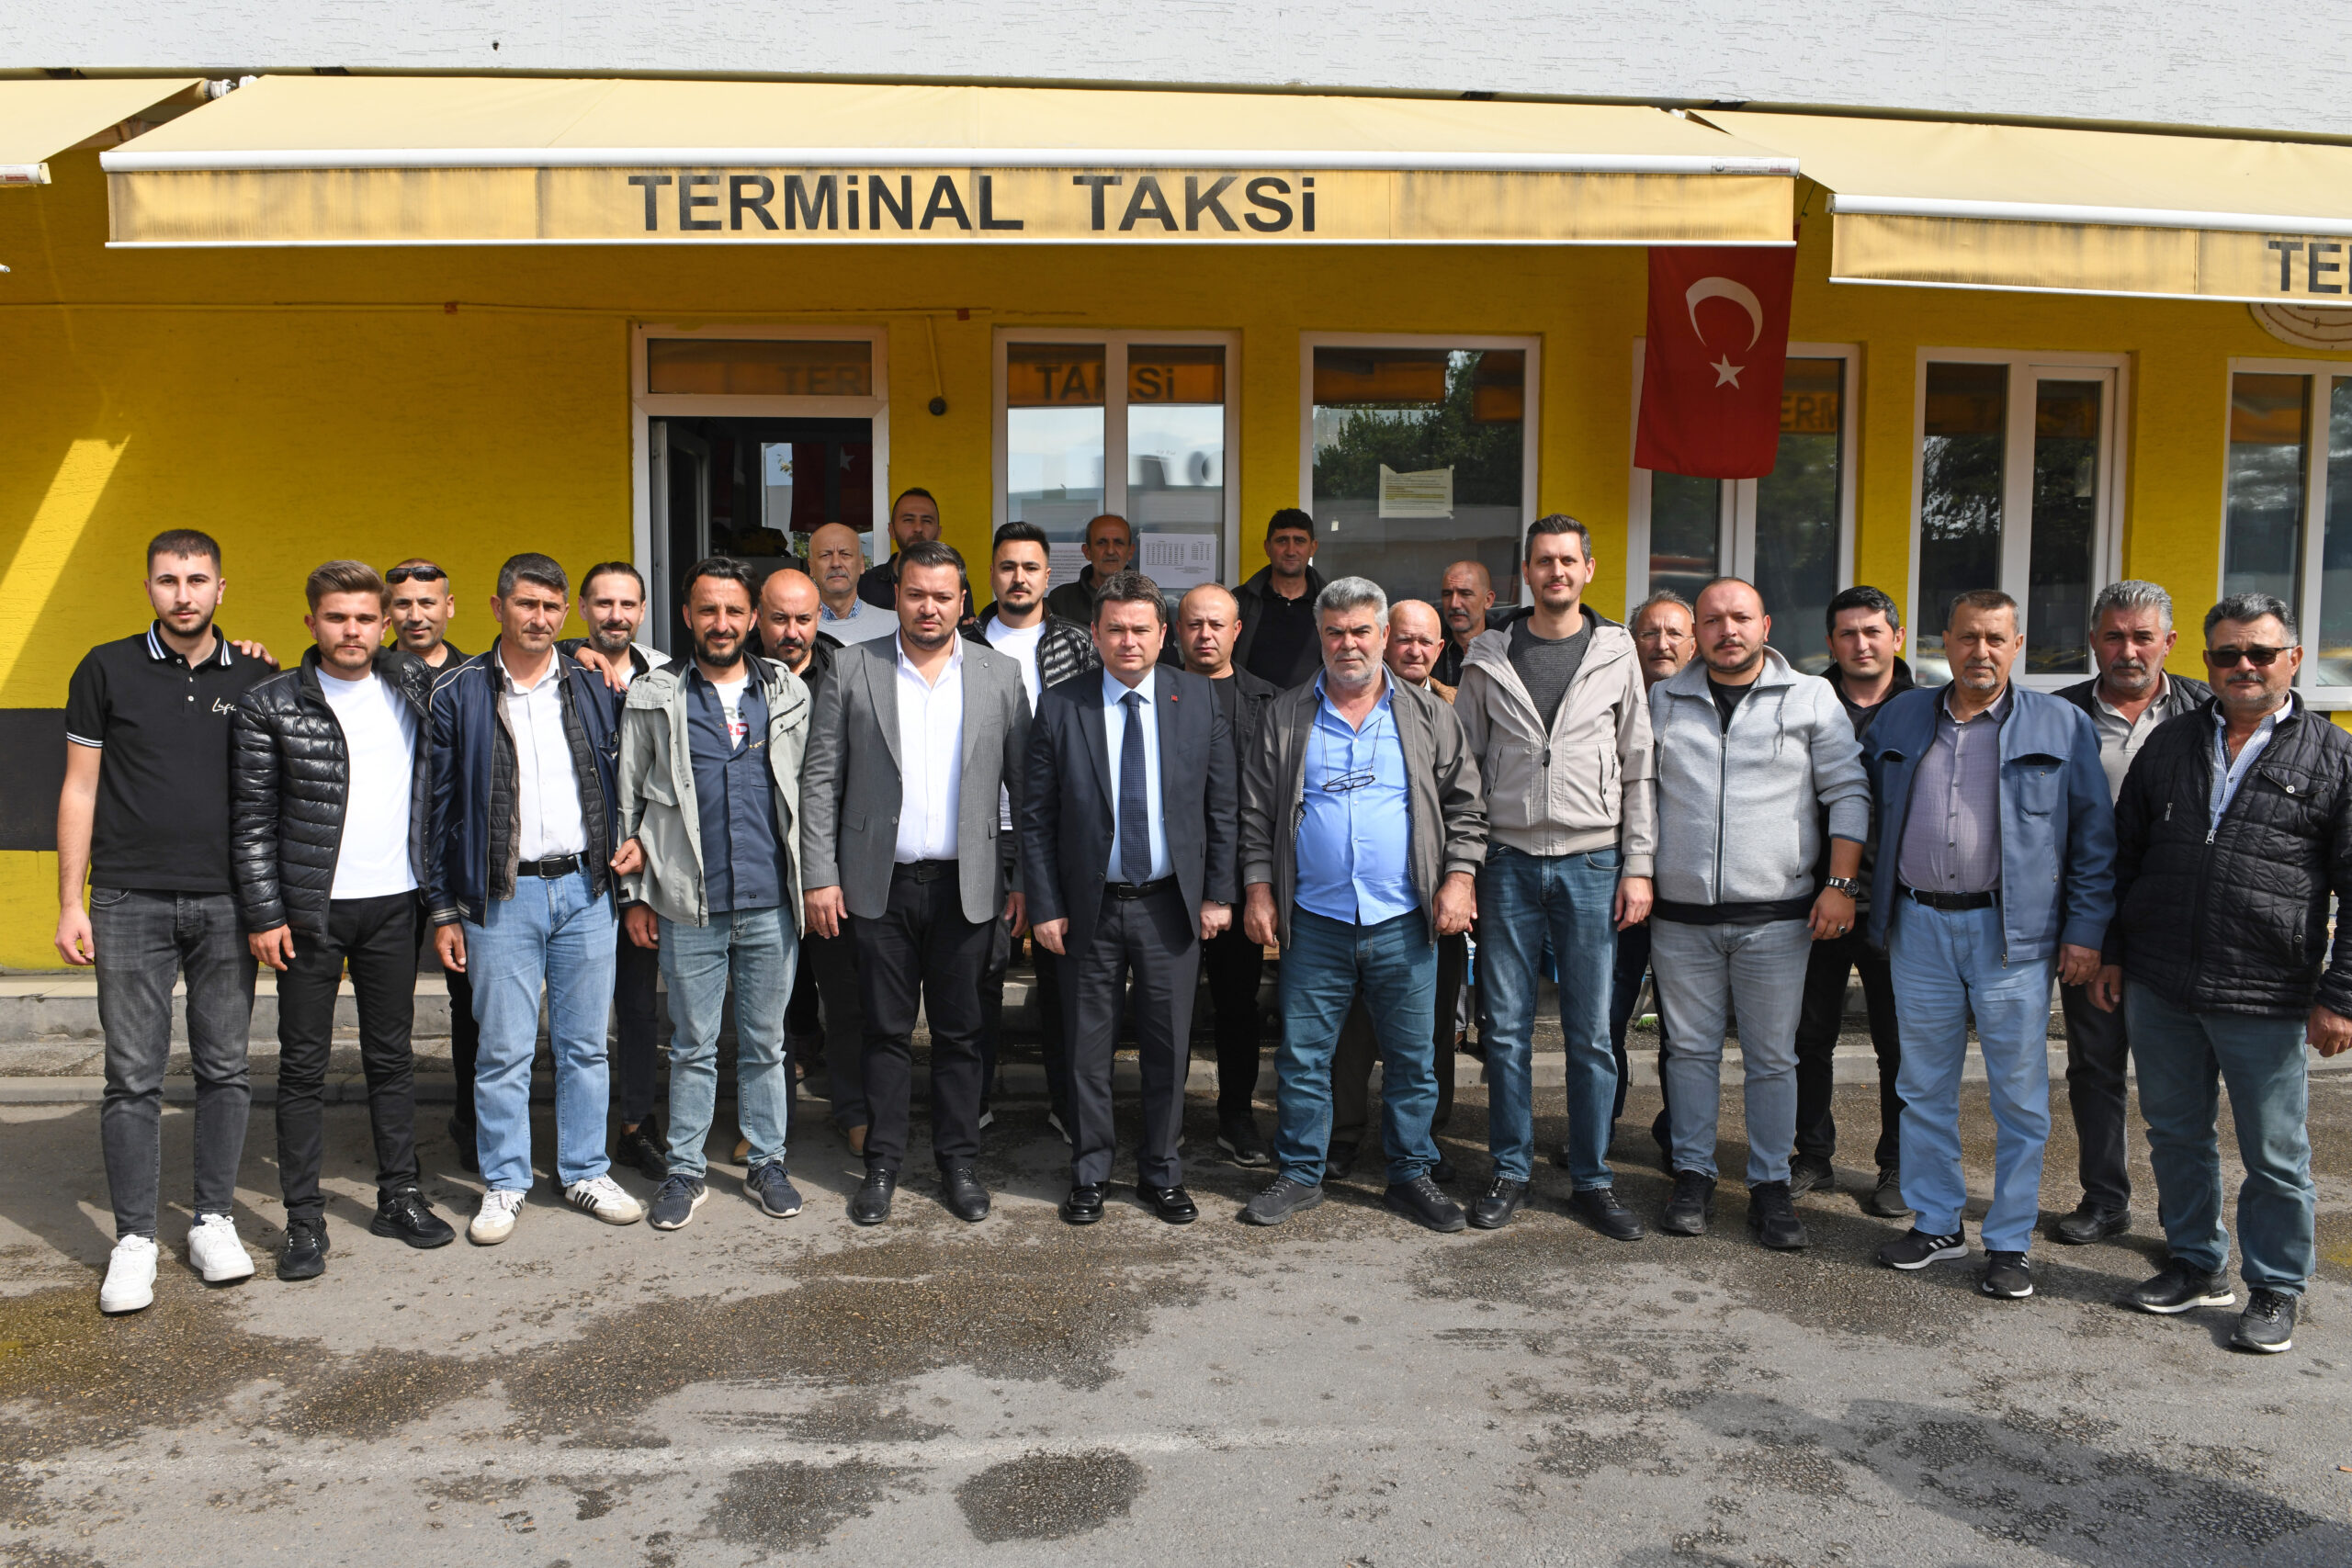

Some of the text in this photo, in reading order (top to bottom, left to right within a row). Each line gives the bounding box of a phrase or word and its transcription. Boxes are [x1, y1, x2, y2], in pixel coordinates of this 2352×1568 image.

[628, 175, 1316, 232] TERMiNAL TAKSi
[2267, 241, 2352, 295] TE
